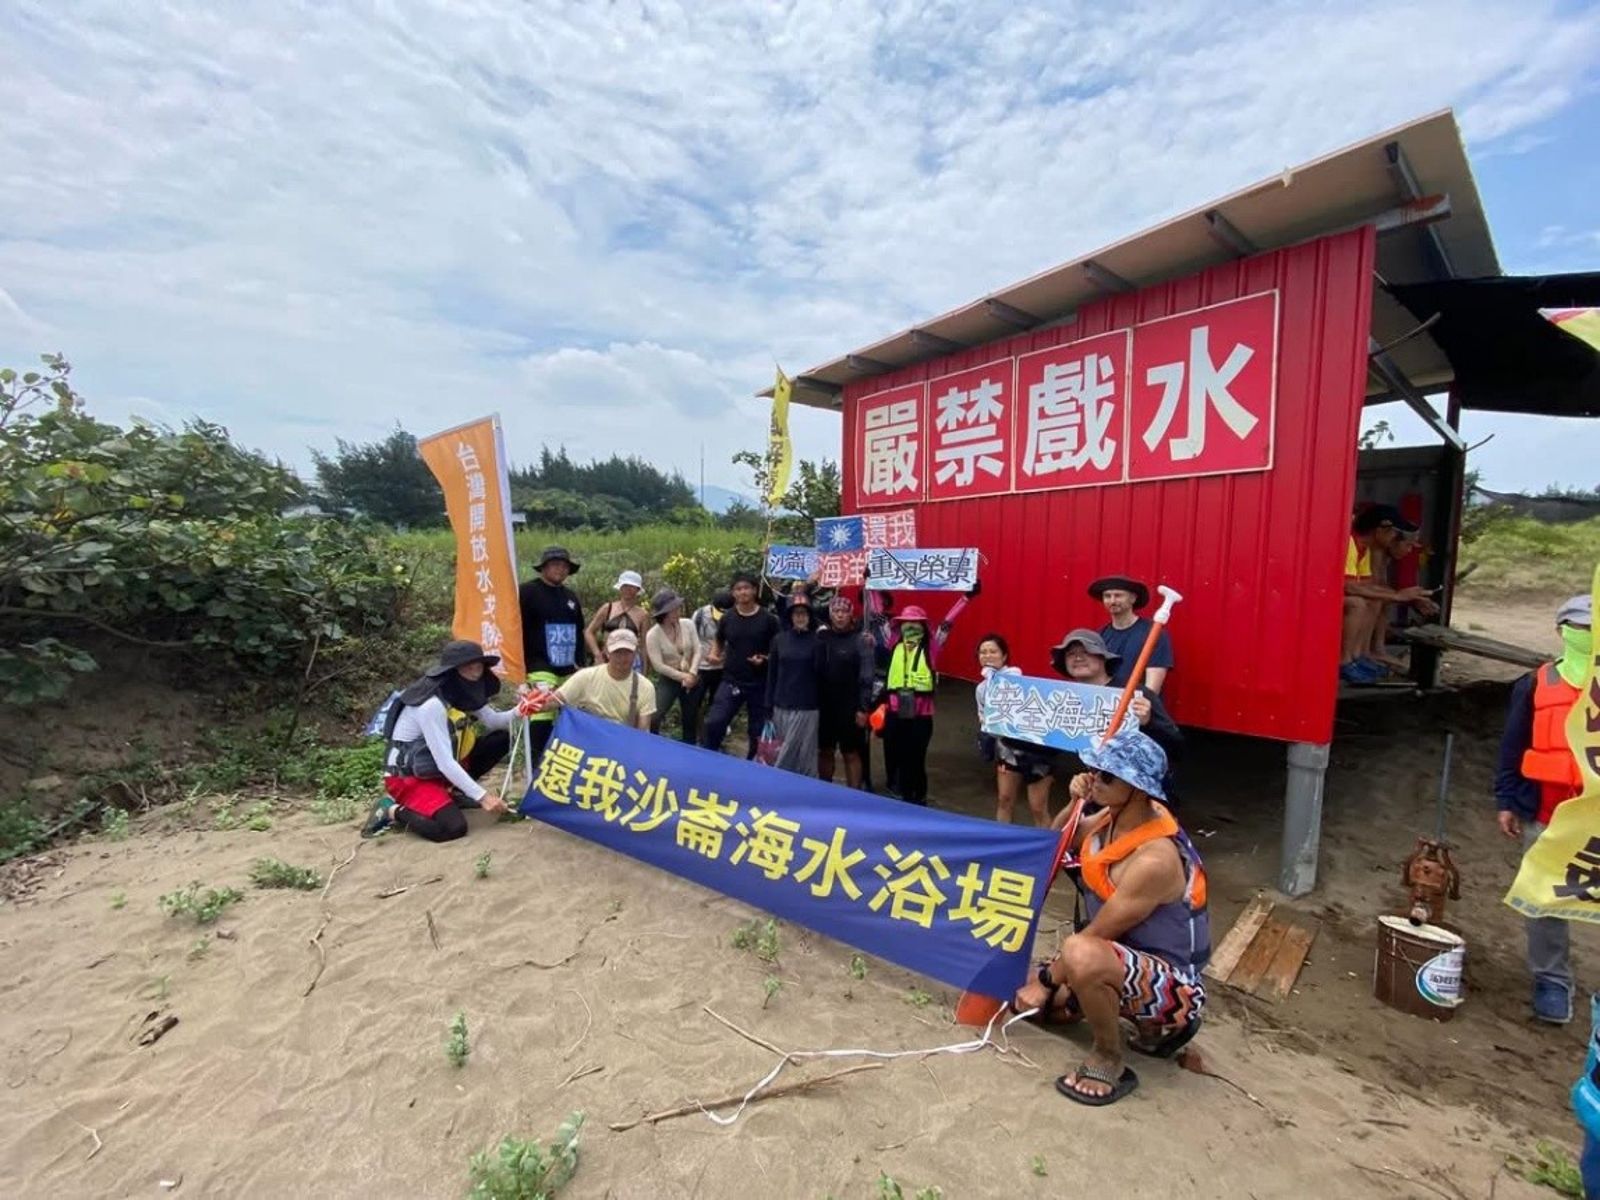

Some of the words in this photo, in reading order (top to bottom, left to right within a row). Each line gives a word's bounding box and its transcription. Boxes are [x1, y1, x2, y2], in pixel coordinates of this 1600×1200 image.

[862, 325, 1259, 497] 嚴禁戲水
[862, 512, 914, 548] 還我
[819, 552, 864, 588] 海洋
[869, 553, 974, 585] 重現榮景
[532, 740, 1036, 953] 還我沙崙海水浴場
